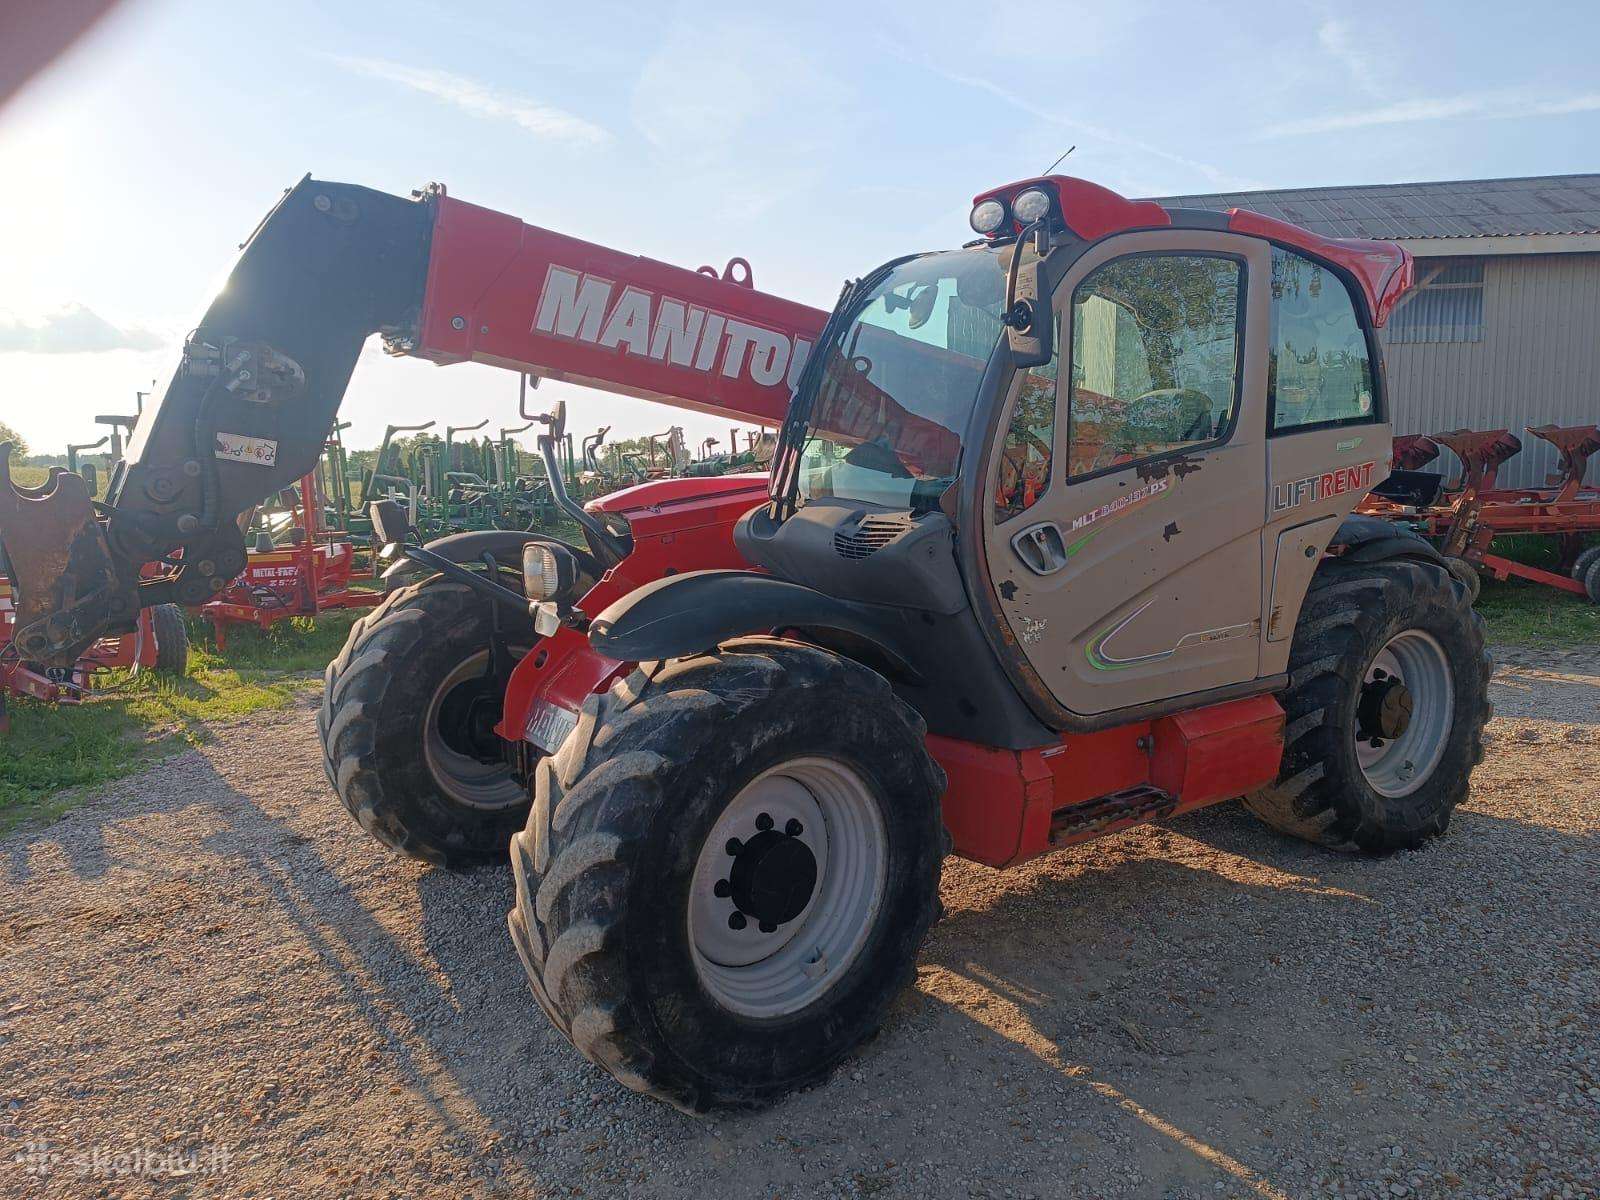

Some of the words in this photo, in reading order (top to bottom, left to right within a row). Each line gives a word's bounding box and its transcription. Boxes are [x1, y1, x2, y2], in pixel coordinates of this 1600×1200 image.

[1072, 509, 1099, 531] MLT
[1150, 479, 1168, 495] PS
[1273, 461, 1377, 512] LIFTRENT
